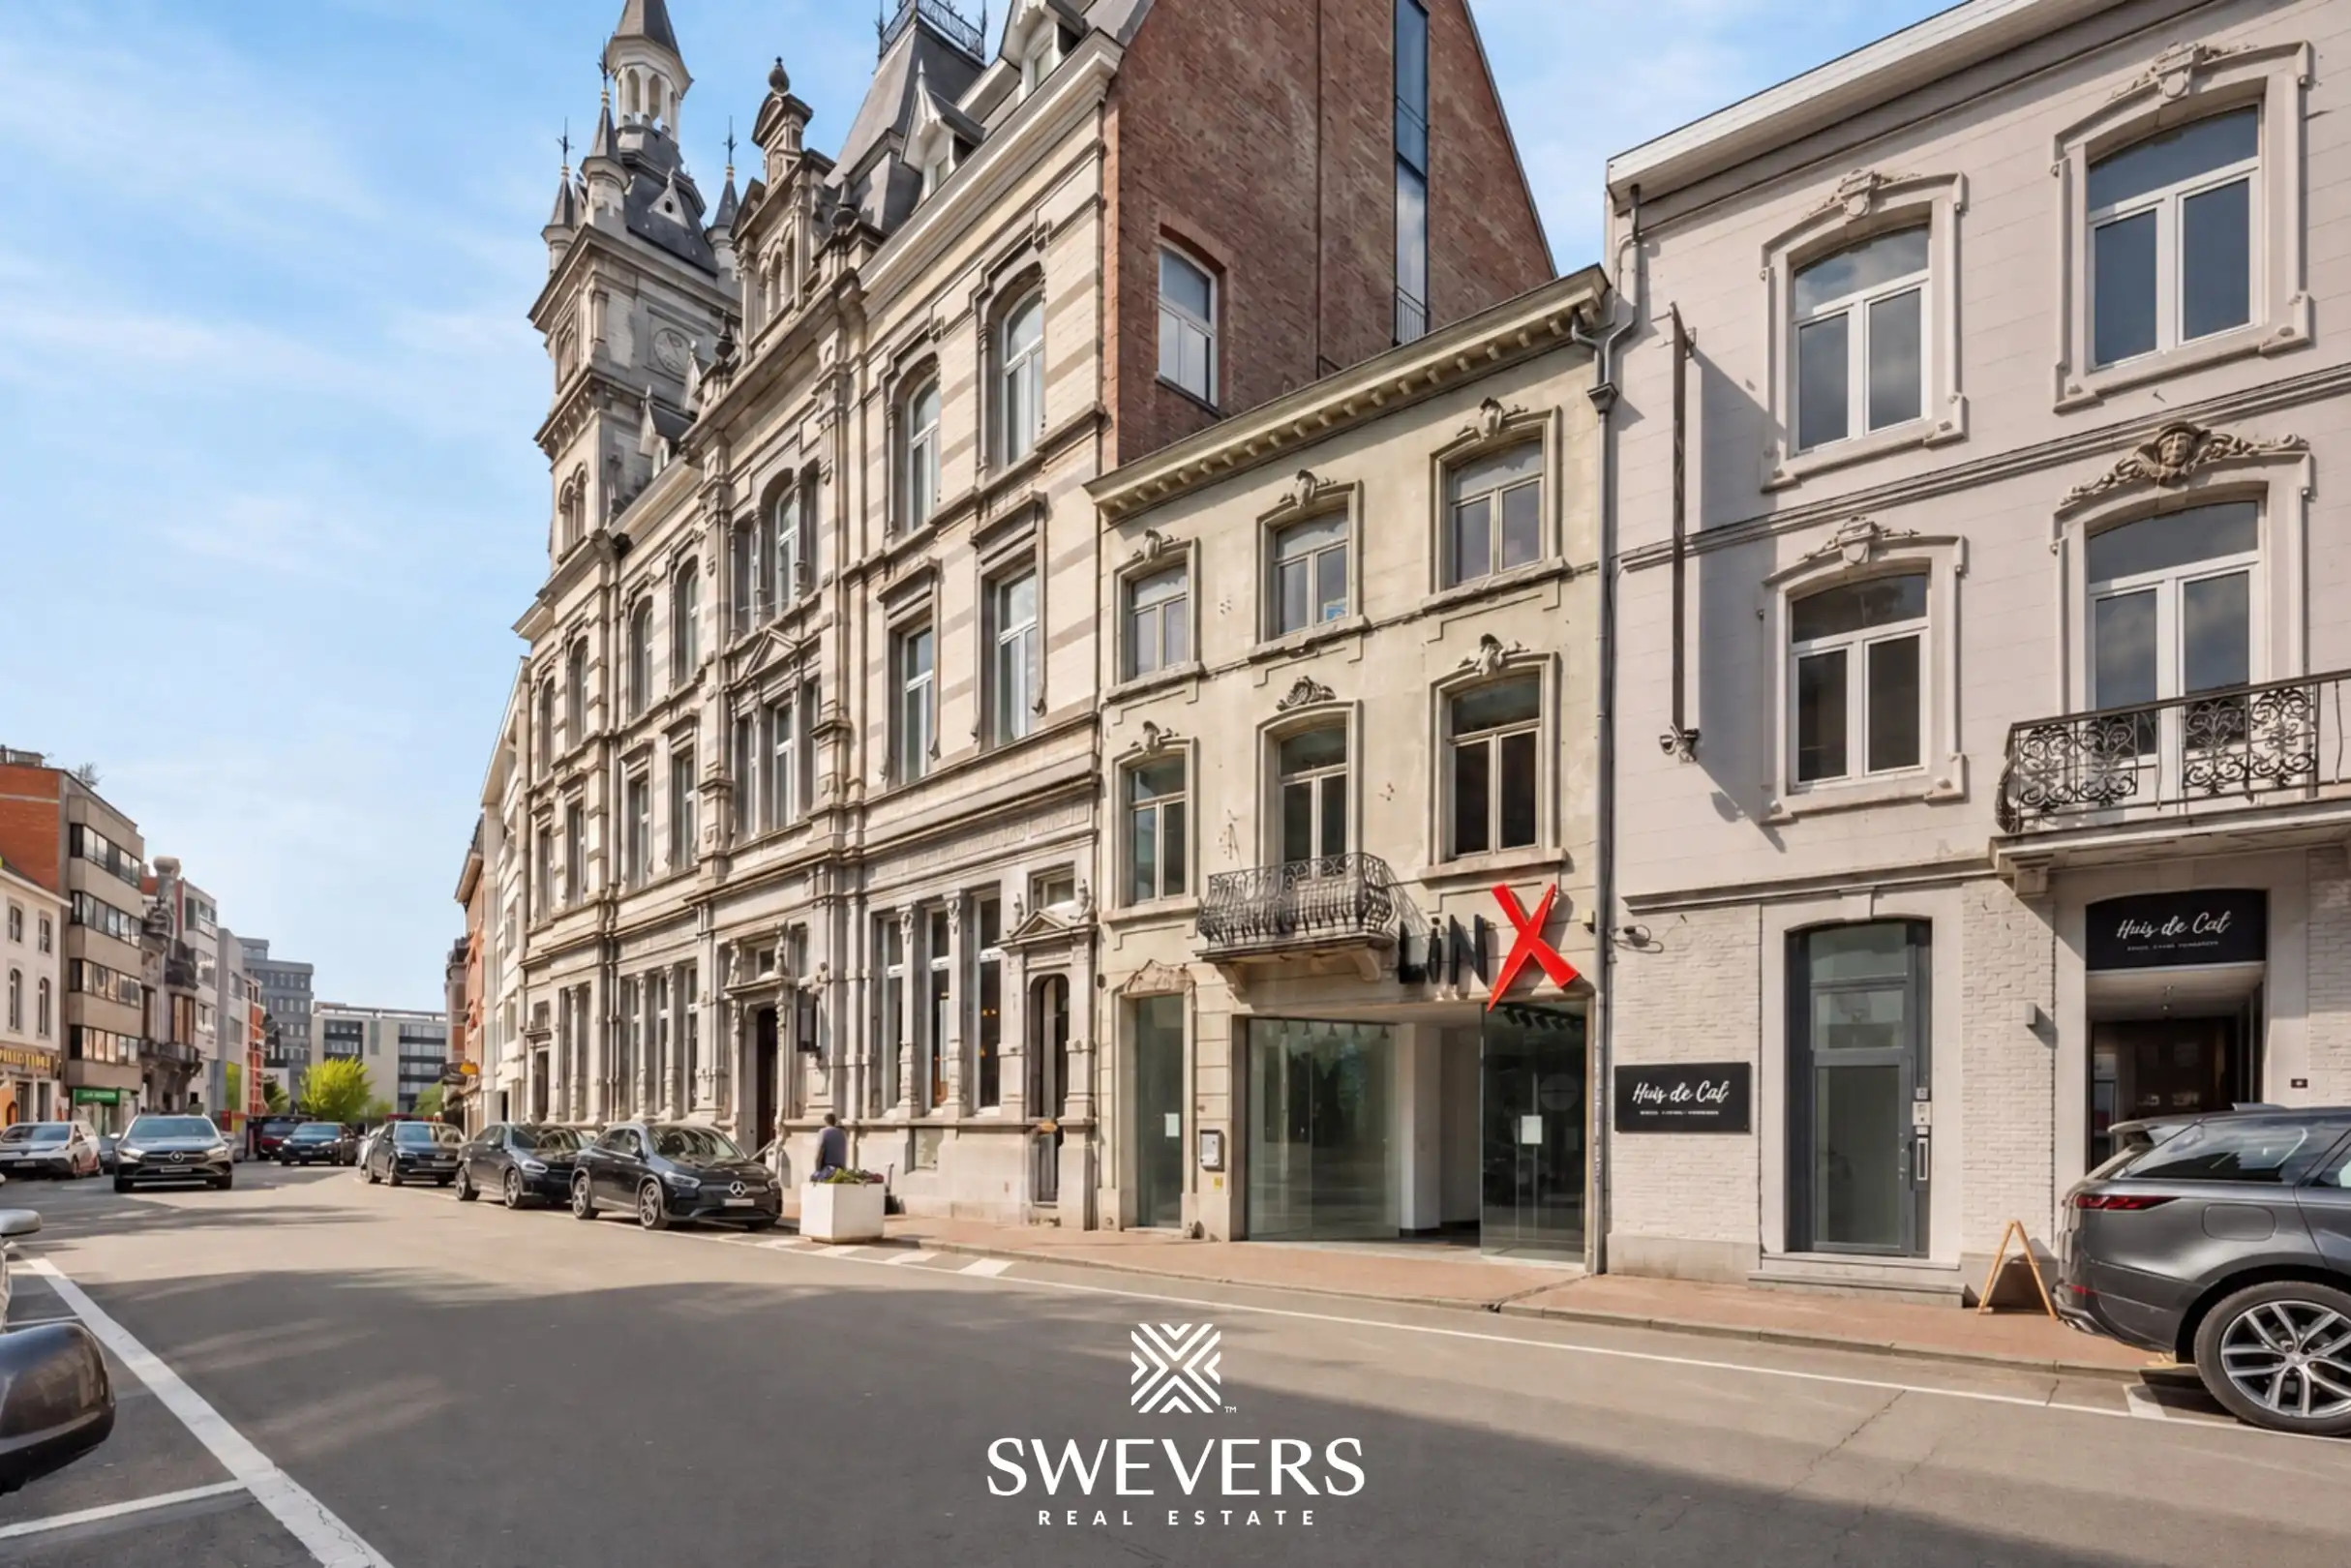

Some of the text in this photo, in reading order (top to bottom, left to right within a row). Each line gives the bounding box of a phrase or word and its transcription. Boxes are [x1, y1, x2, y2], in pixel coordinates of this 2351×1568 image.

[2116, 919, 2159, 940] Huis
[2160, 915, 2187, 936] de
[1632, 1081, 1667, 1104] Huis
[1670, 1081, 1694, 1102] de
